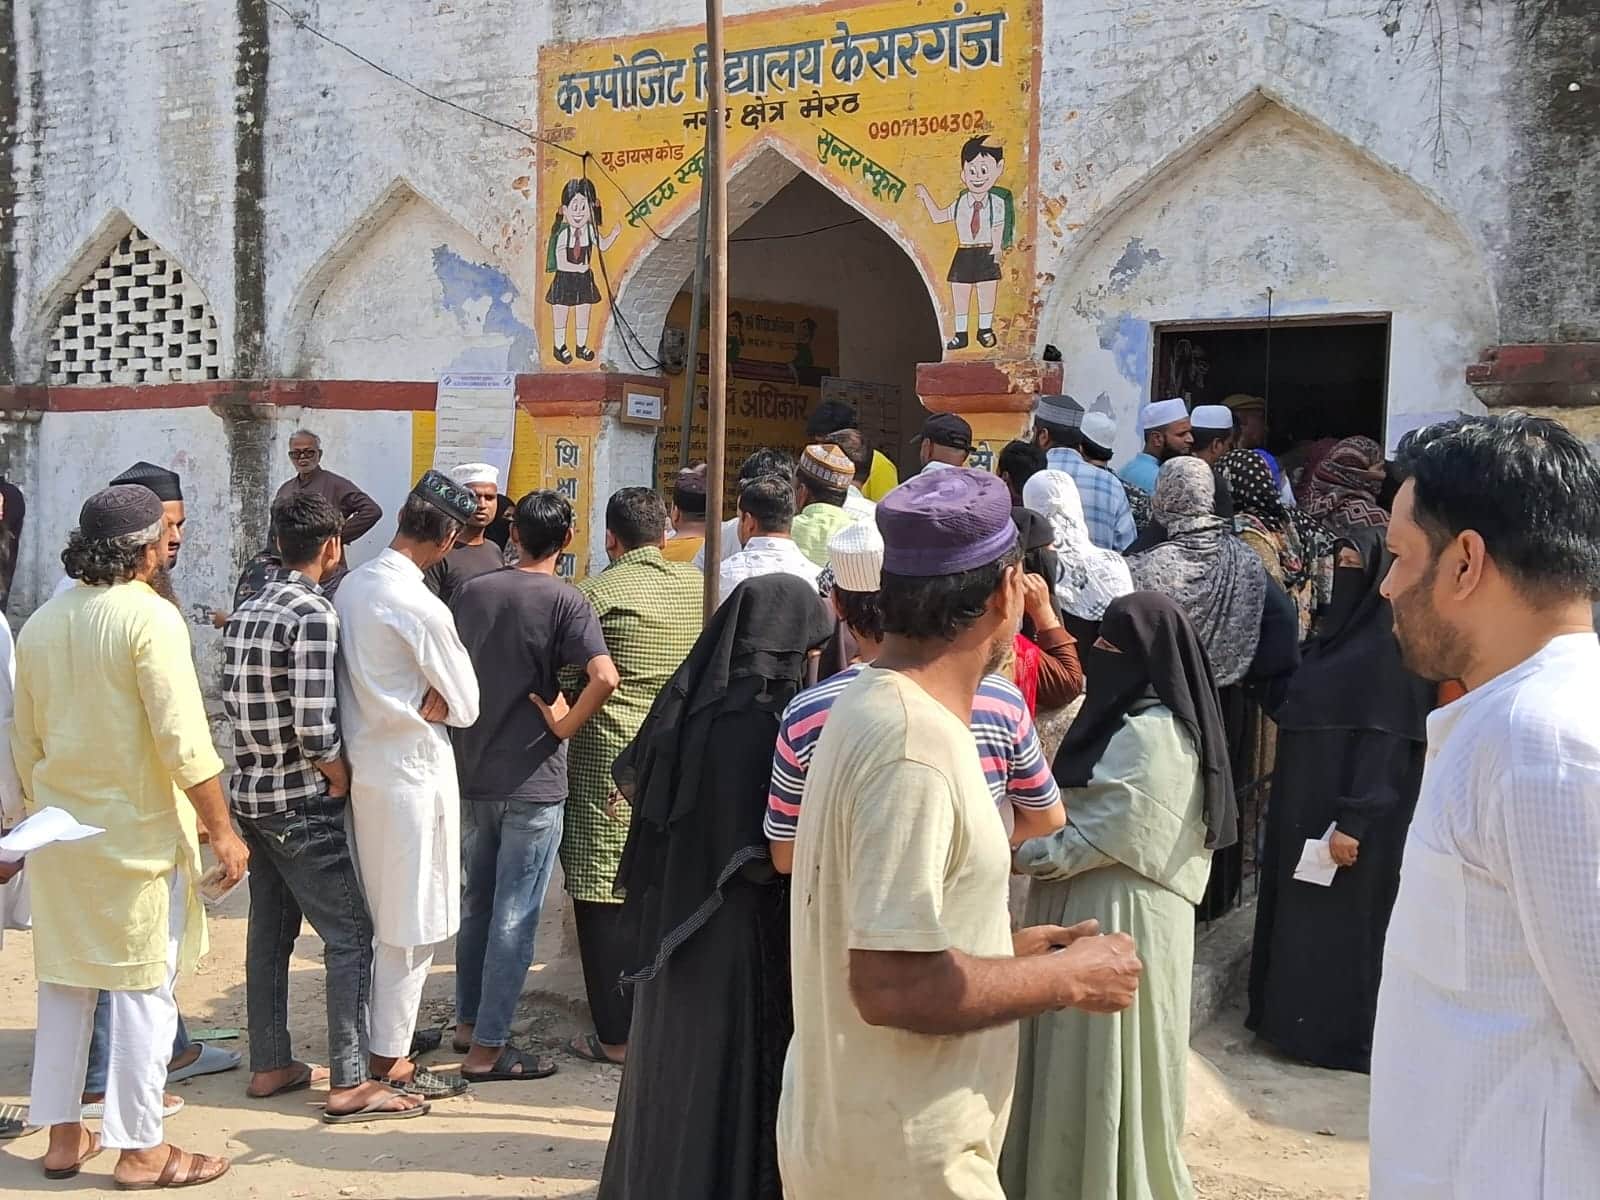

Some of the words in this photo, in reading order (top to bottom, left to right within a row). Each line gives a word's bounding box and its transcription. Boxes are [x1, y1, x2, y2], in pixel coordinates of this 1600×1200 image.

[557, 48, 687, 114] कम्पोजिट
[693, 40, 825, 99] िद्यालय
[831, 2, 1005, 83] केसरगंज
[741, 95, 788, 130] क्षेत्र
[799, 90, 860, 118] मेरठ
[868, 110, 985, 140] 09071304302
[615, 148, 654, 168] डायस
[655, 139, 685, 161] कोड
[817, 128, 864, 174] सुन्दर
[862, 157, 907, 204] स्कूल
